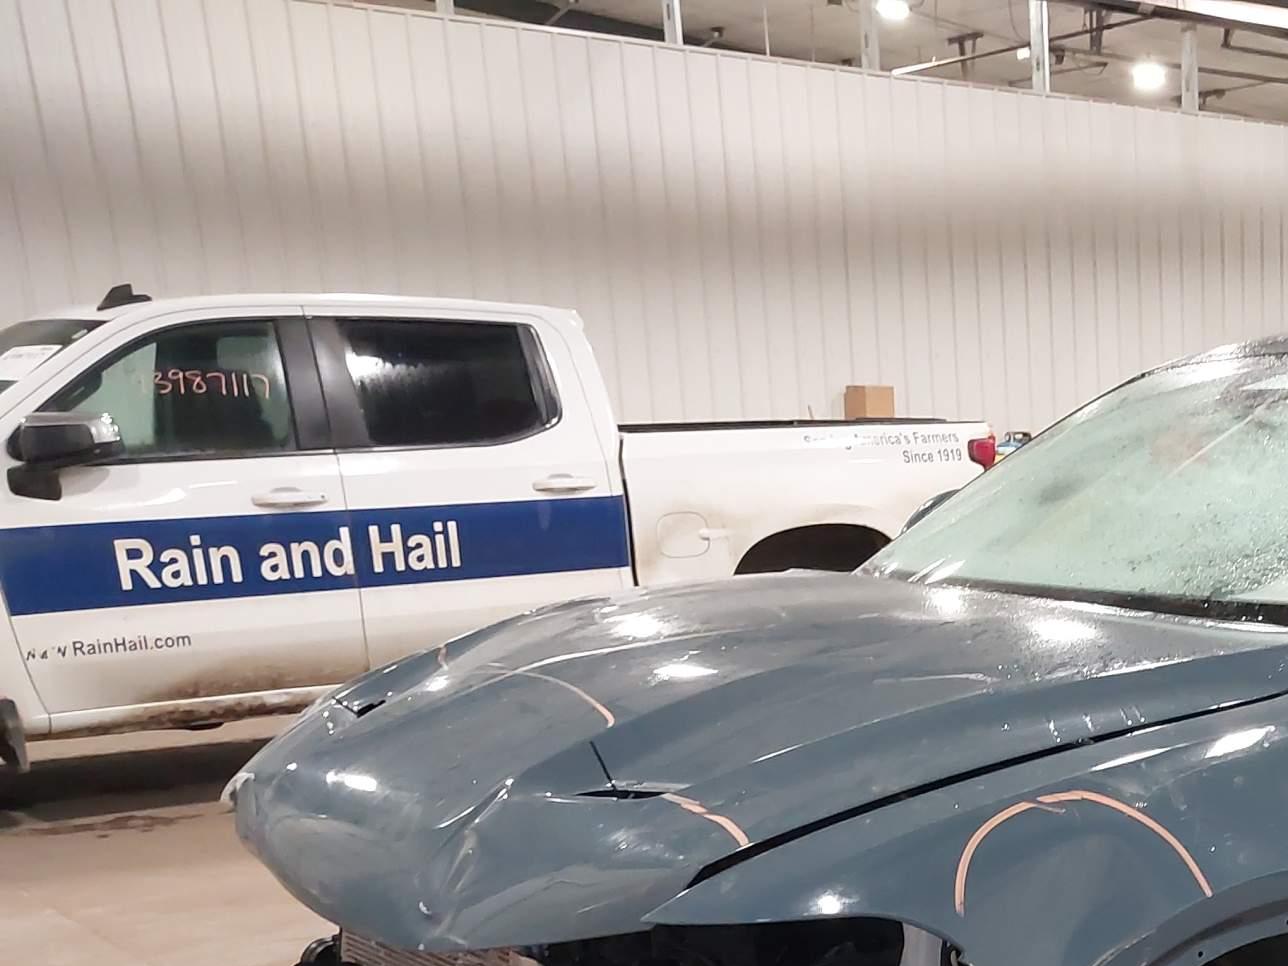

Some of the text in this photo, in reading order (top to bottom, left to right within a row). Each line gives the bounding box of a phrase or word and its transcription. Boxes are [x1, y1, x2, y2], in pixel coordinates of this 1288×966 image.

[852, 431, 911, 448] erica's
[913, 431, 959, 445] Farmers
[902, 448, 962, 464] Since 1919
[113, 521, 461, 591] Rain and Hail
